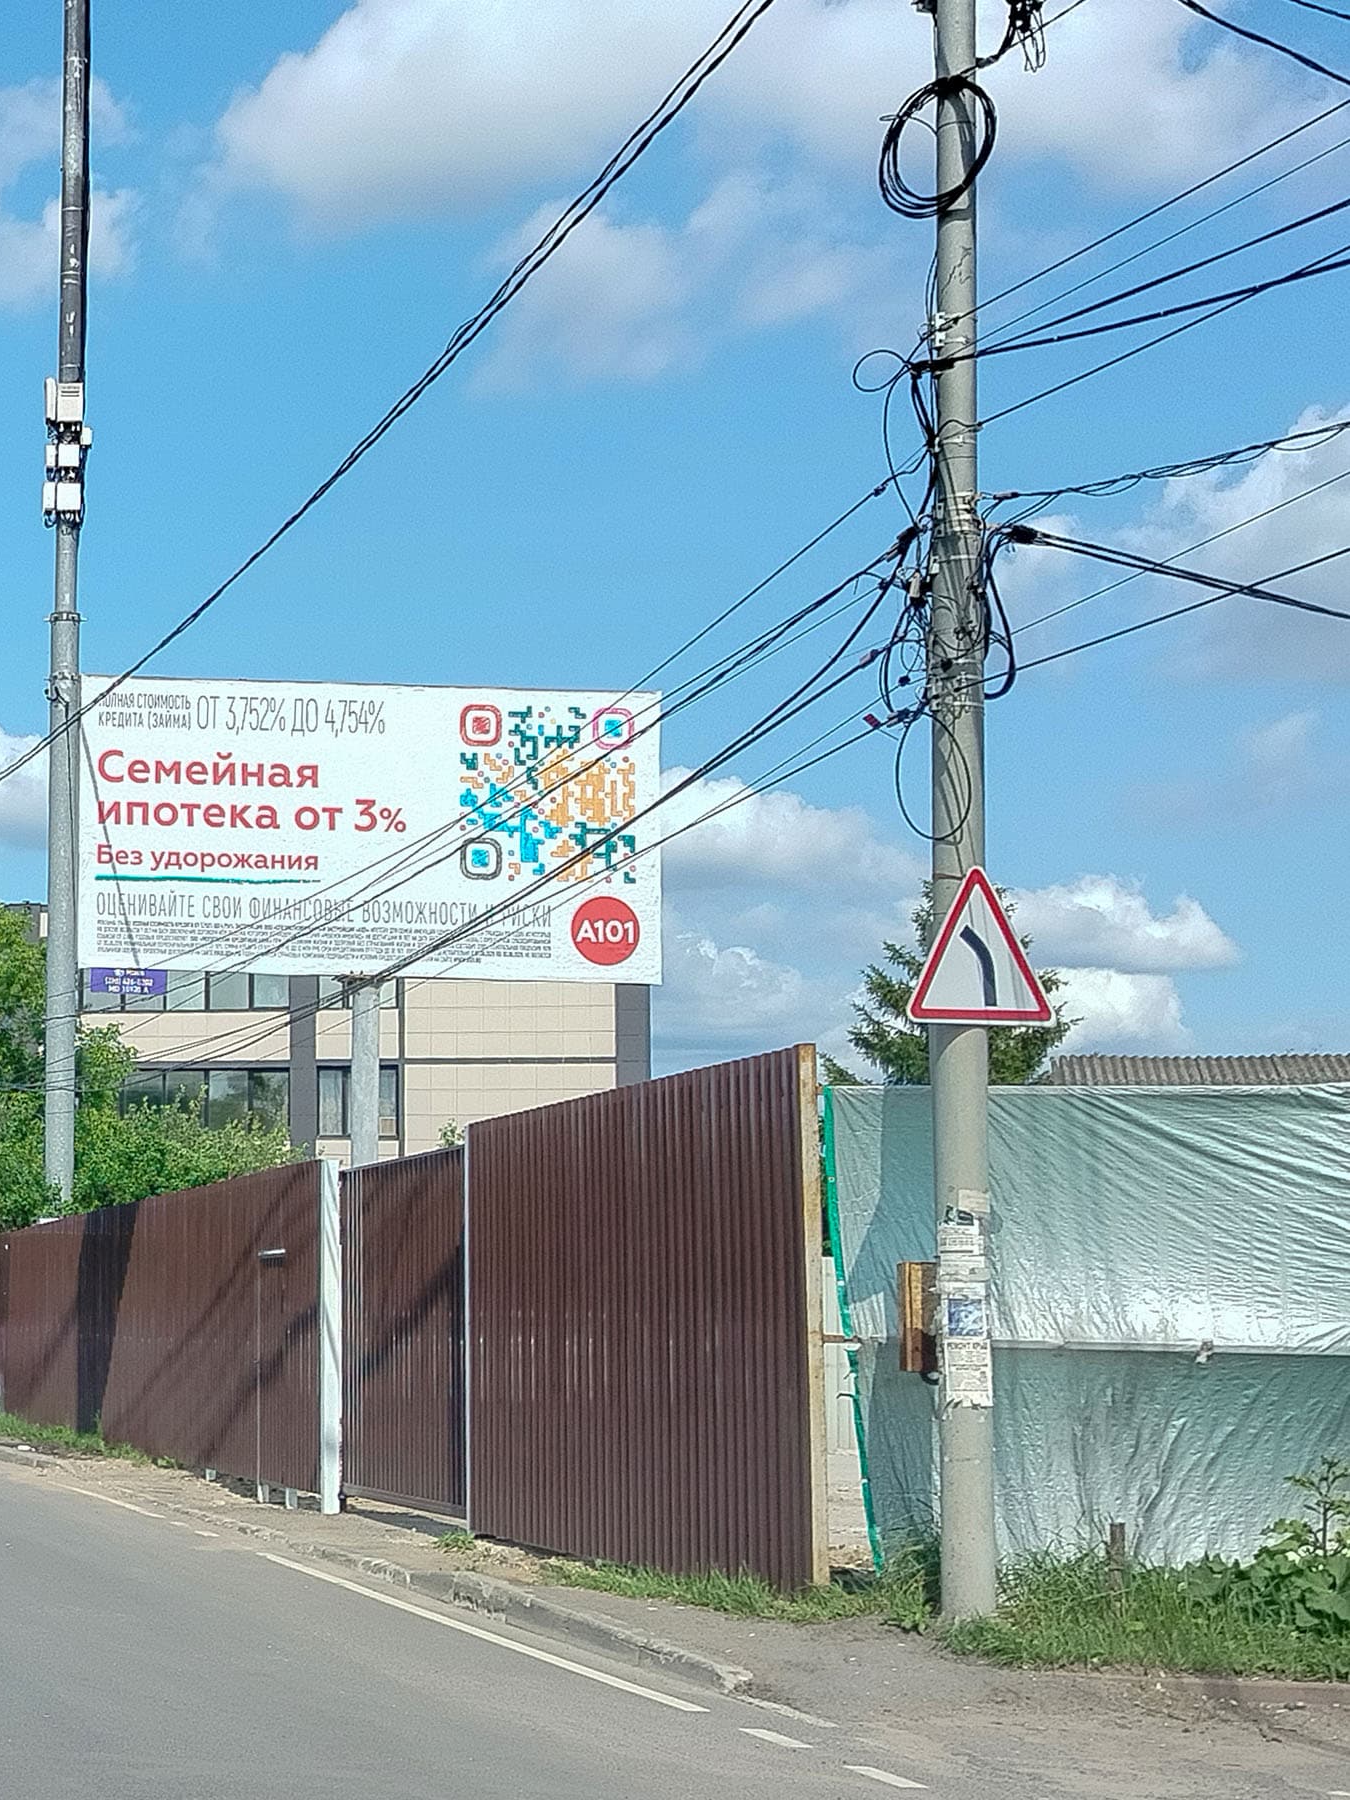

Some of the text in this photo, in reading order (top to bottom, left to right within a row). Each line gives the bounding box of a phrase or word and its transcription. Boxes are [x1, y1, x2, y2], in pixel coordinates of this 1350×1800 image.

[99, 692, 191, 710] ОЛНАЯ СТОИМОСТЬ
[197, 695, 386, 738] ОТ 3,752% ДО 4,754%
[98, 710, 191, 730] КРЕДИТА (ЗАЙМА)
[98, 749, 319, 788] Семейная
[97, 799, 407, 833] ипотека от 3%
[96, 844, 319, 872] Без удорожания
[96, 889, 195, 919] ОЦЕНИВАЙТЕ
[202, 895, 242, 919] СВОИ
[362, 899, 477, 926] ВОЗМОЖНОСТИ
